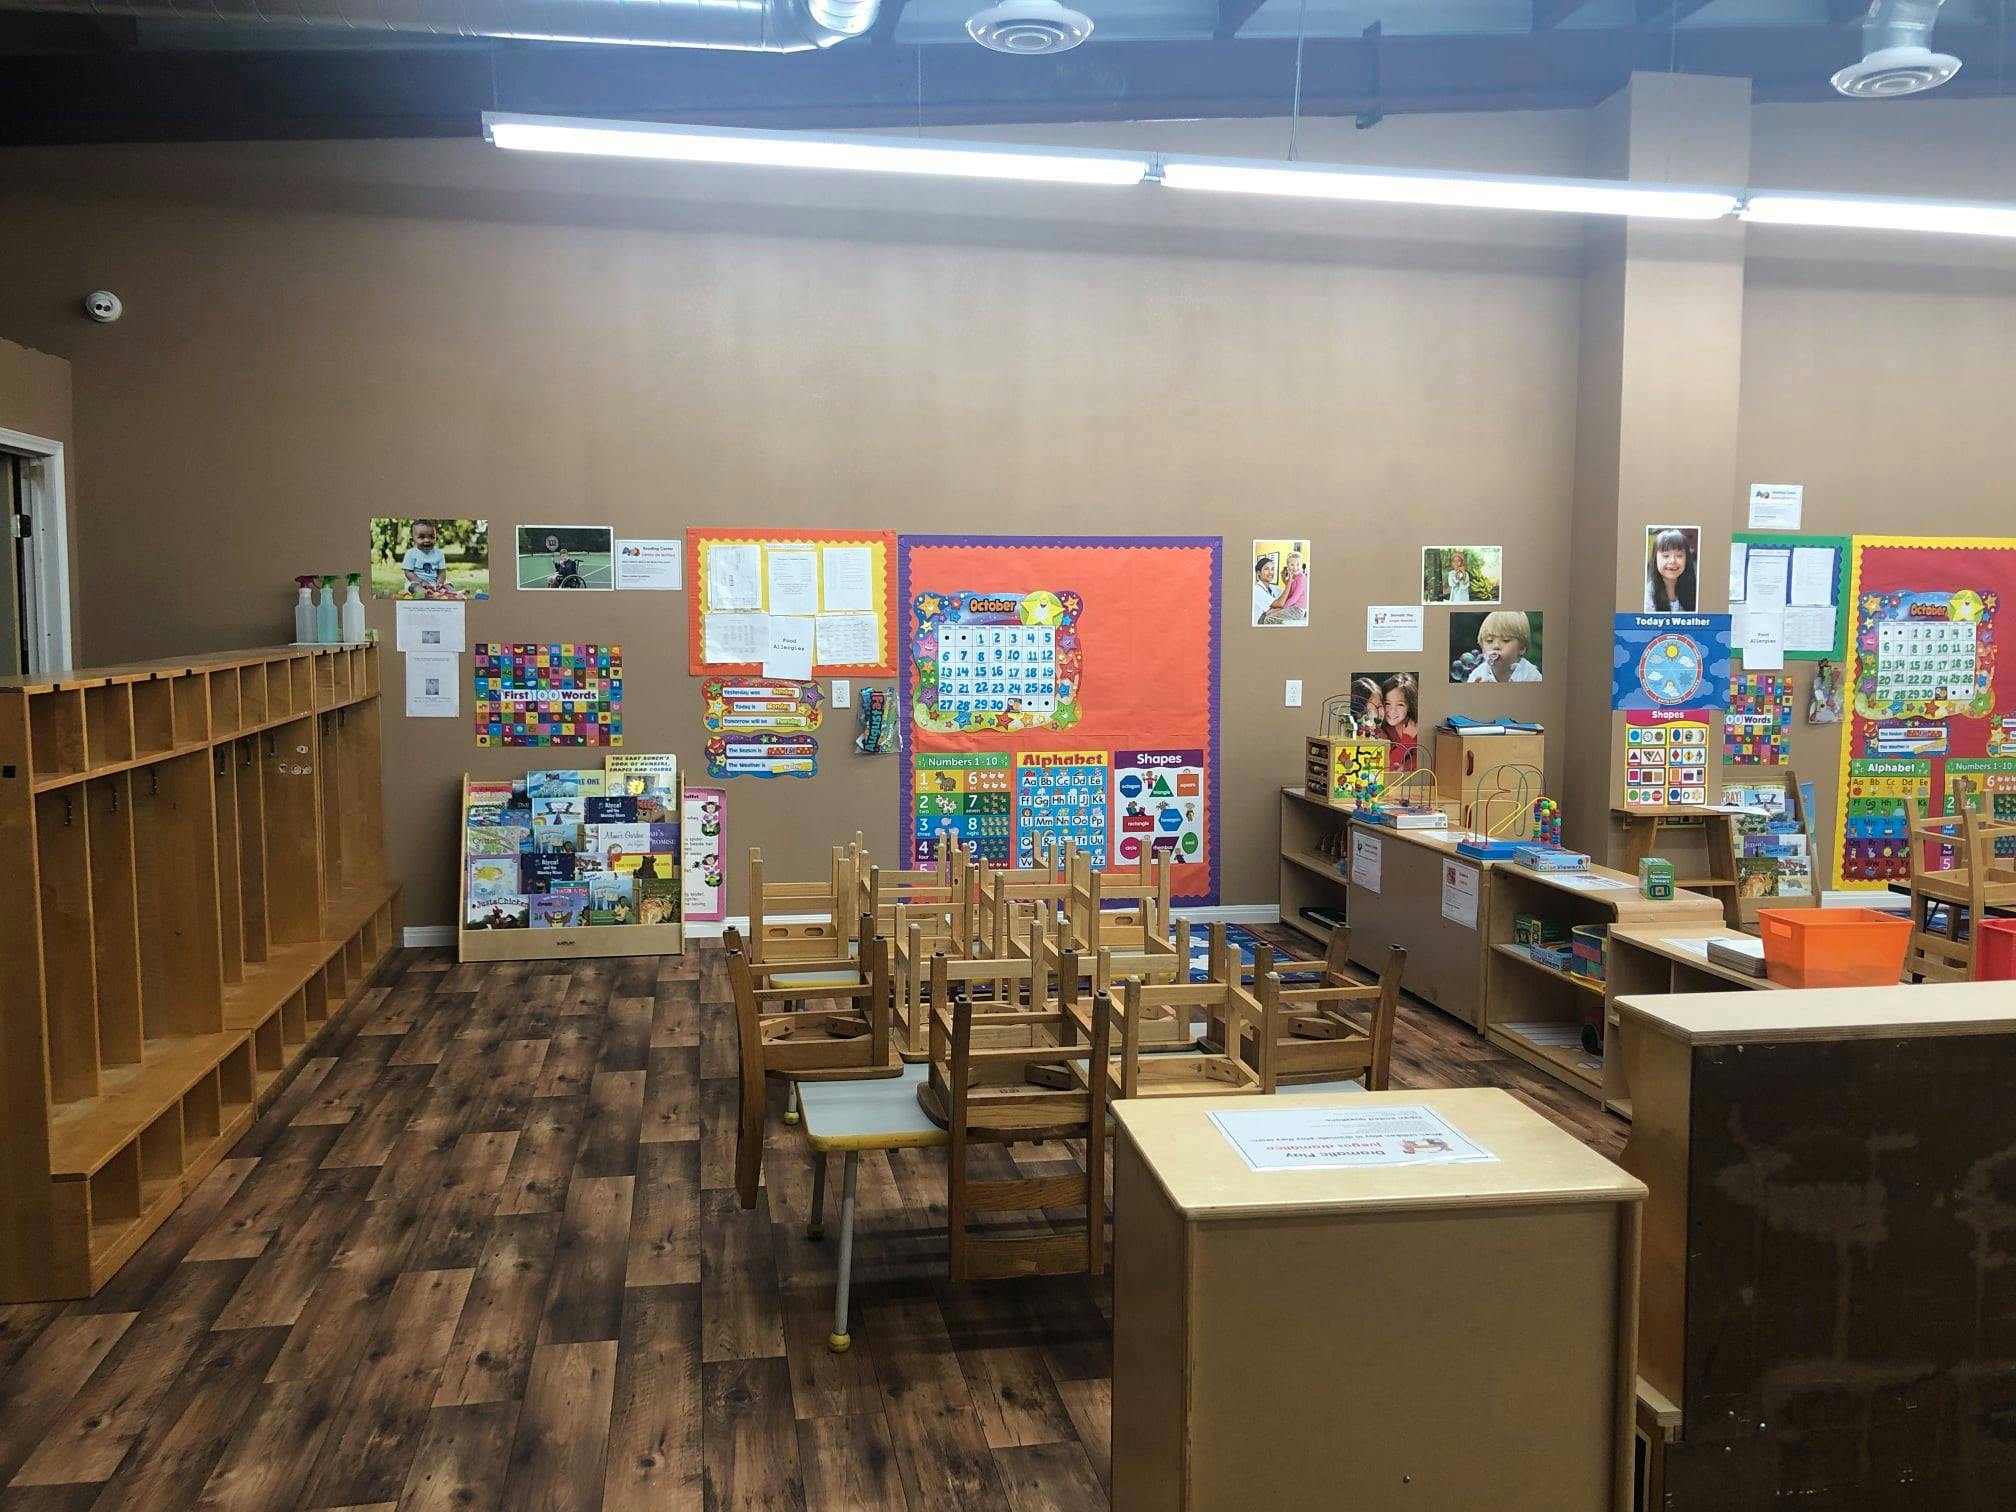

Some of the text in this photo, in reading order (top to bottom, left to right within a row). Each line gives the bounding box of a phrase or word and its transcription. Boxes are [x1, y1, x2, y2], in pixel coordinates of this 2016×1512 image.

[970, 598, 1016, 612] October
[1910, 602, 1947, 616] October
[1636, 617, 1670, 627] Today's
[978, 633, 1051, 644] 1 2 3 4 5
[1913, 628, 1973, 638] 1 2 3 4 5
[1884, 642, 1975, 653] 6 7 8 9 10 11 12
[942, 650, 1053, 661] 6 7 8 9 10 11 12
[1882, 659, 1974, 670] 13 14 15 16 17 18 19
[941, 666, 1053, 677] 13 14 15 16 17 18 19
[1879, 674, 1973, 685] 20 21 22 23 24 25 26
[939, 682, 1053, 693] 20 21 22 23 24 25 26
[531, 690, 560, 700] 100
[562, 691, 596, 699] Words
[1879, 690, 1933, 700] 27 28 29 30
[940, 700, 1003, 711] 27 28 29 30
[1652, 711, 1684, 719] Shapes
[1744, 716, 1771, 724] Words
[1023, 754, 1103, 768] Alphabet
[1137, 753, 1182, 766] Shapes
[1868, 764, 1914, 774] Alphabet
[920, 772, 978, 785] 1 6
[1090, 776, 1100, 784] Ee
[1987, 776, 1994, 786] 6
[920, 795, 977, 808] 2 7
[1035, 797, 1049, 808] Gg
[1080, 796, 1088, 806] Jj
[1722, 792, 1742, 802] PRAY!
[1947, 797, 1954, 808] 2
[1866, 800, 1876, 808] Gg
[920, 817, 977, 831] 3 8
[1092, 817, 1102, 826] Pp
[1091, 836, 1102, 844] Uu
[919, 841, 977, 853] 4 9
[1944, 859, 1950, 869] 5
[498, 898, 529, 909] Chicken
